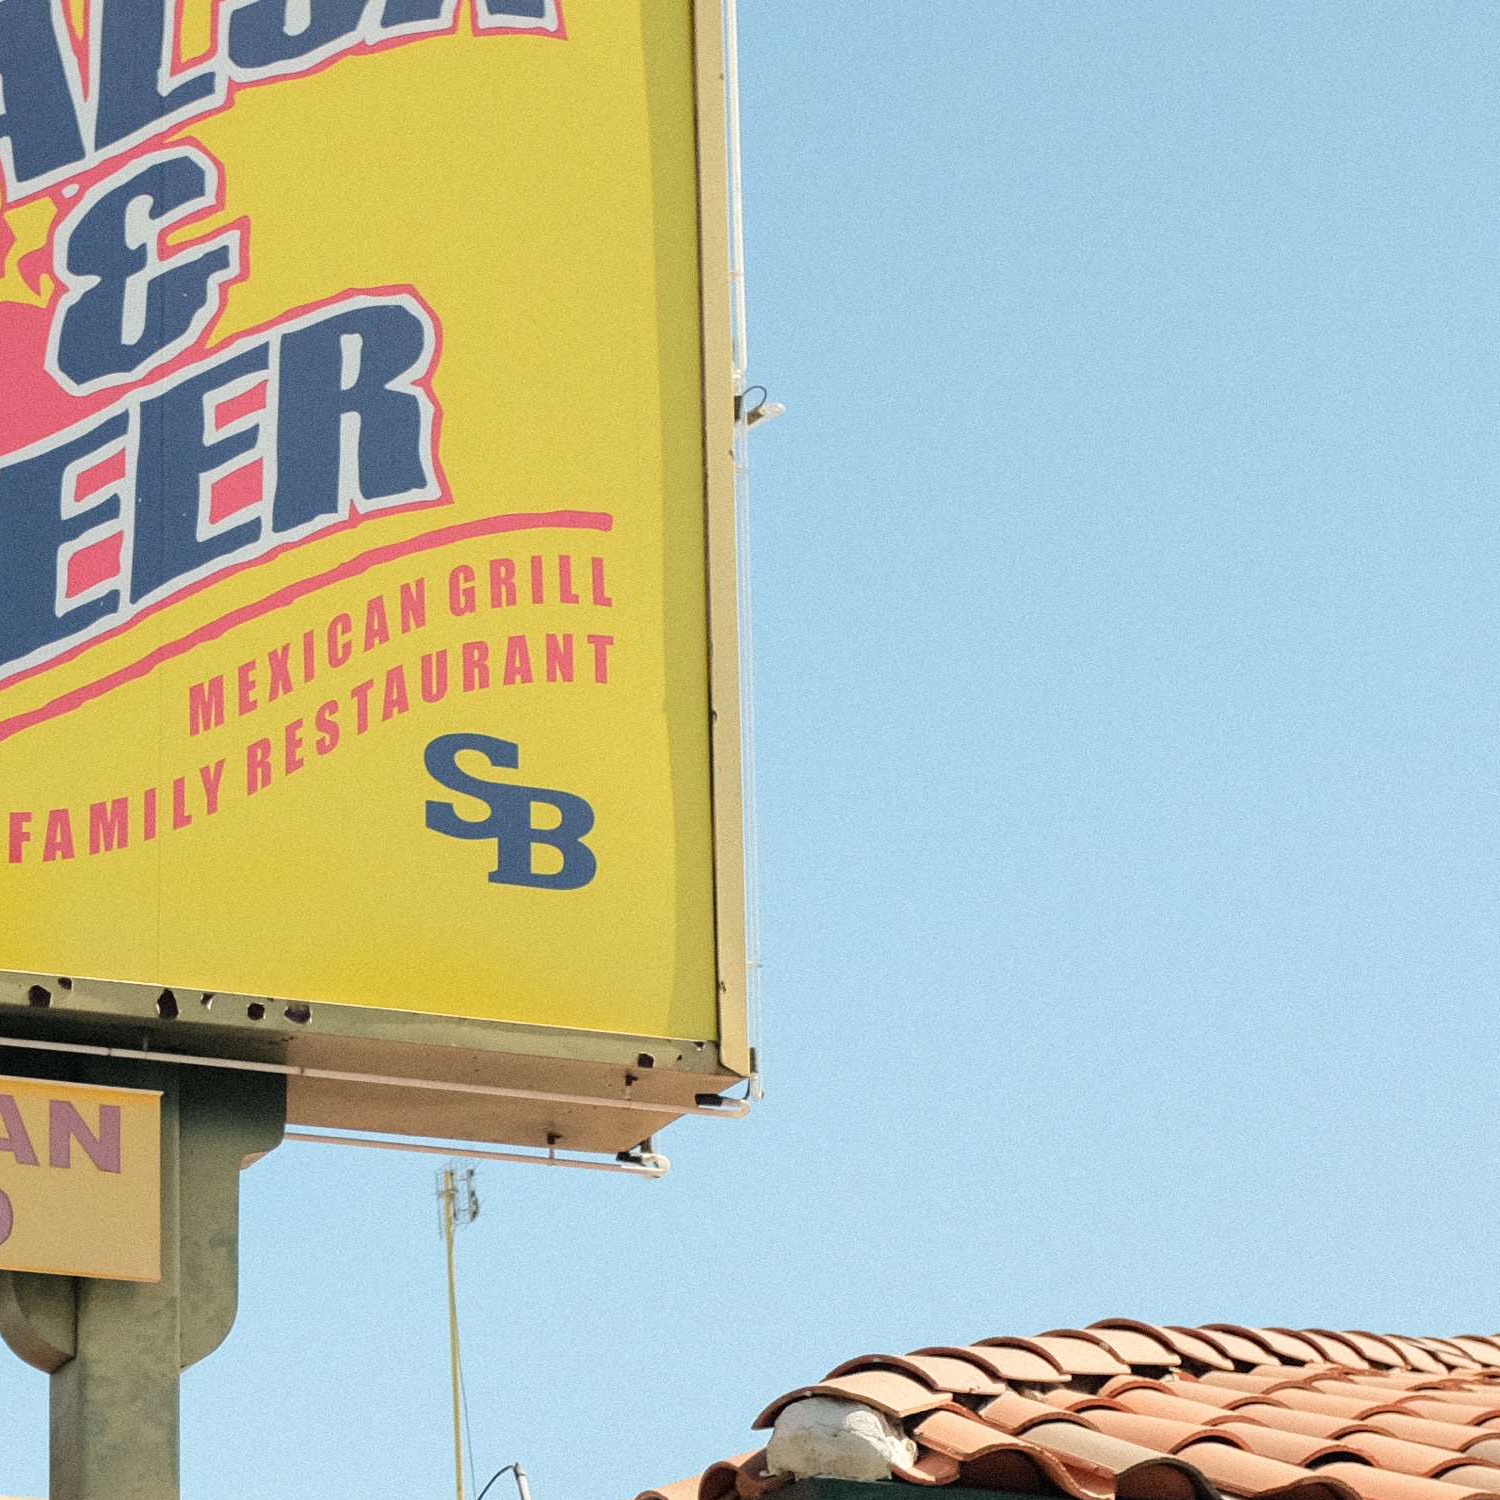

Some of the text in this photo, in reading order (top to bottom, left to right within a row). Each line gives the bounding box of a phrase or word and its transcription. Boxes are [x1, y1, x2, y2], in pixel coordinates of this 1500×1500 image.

[52, 150, 235, 390] &
[8, 634, 613, 864] FAMILY RESTAURANT
[190, 555, 613, 735] MEXICAN GRILL
